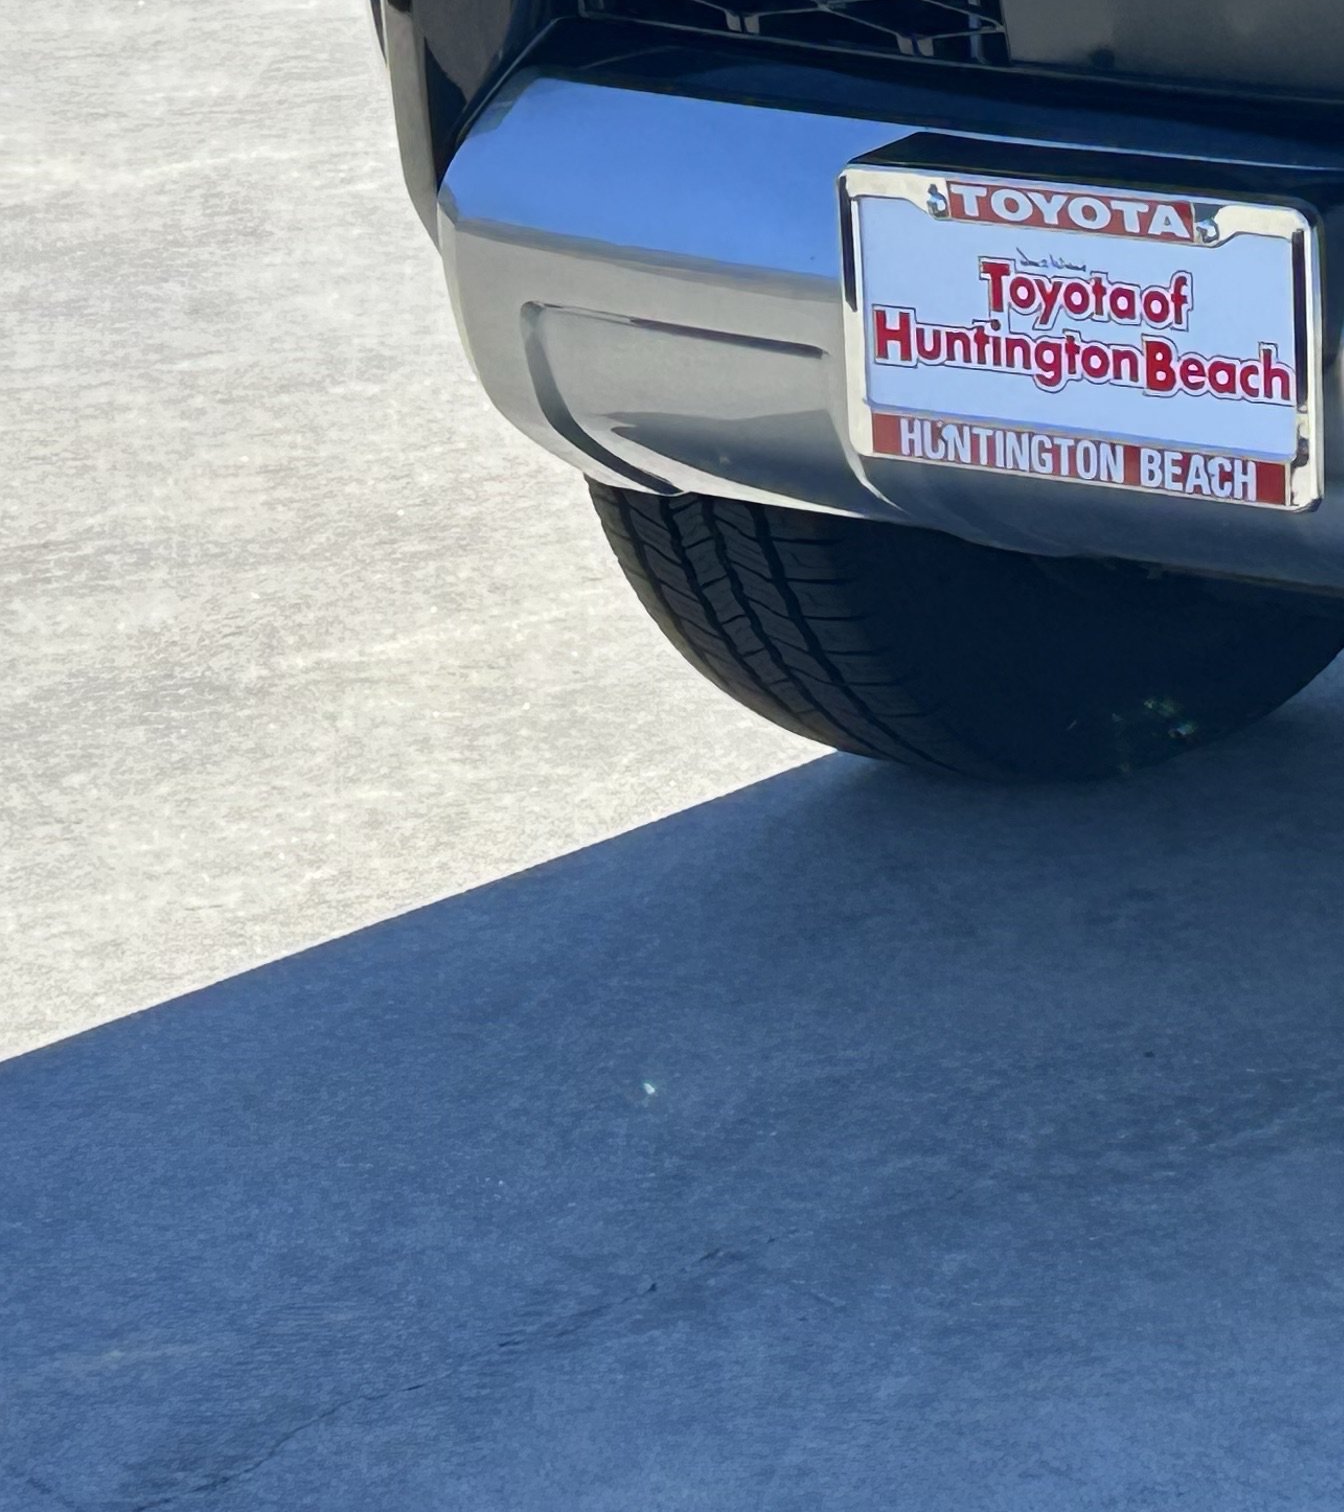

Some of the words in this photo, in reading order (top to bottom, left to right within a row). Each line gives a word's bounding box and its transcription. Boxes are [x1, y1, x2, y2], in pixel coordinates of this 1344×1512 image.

[950, 186, 1191, 240] TOYOTA
[982, 259, 1138, 326] Toyota
[1142, 274, 1189, 326] of
[873, 308, 1138, 388] Huntington
[1144, 338, 1292, 401] Beach
[900, 417, 1125, 485] HUNTINGTON
[1140, 451, 1257, 502] BEACH
